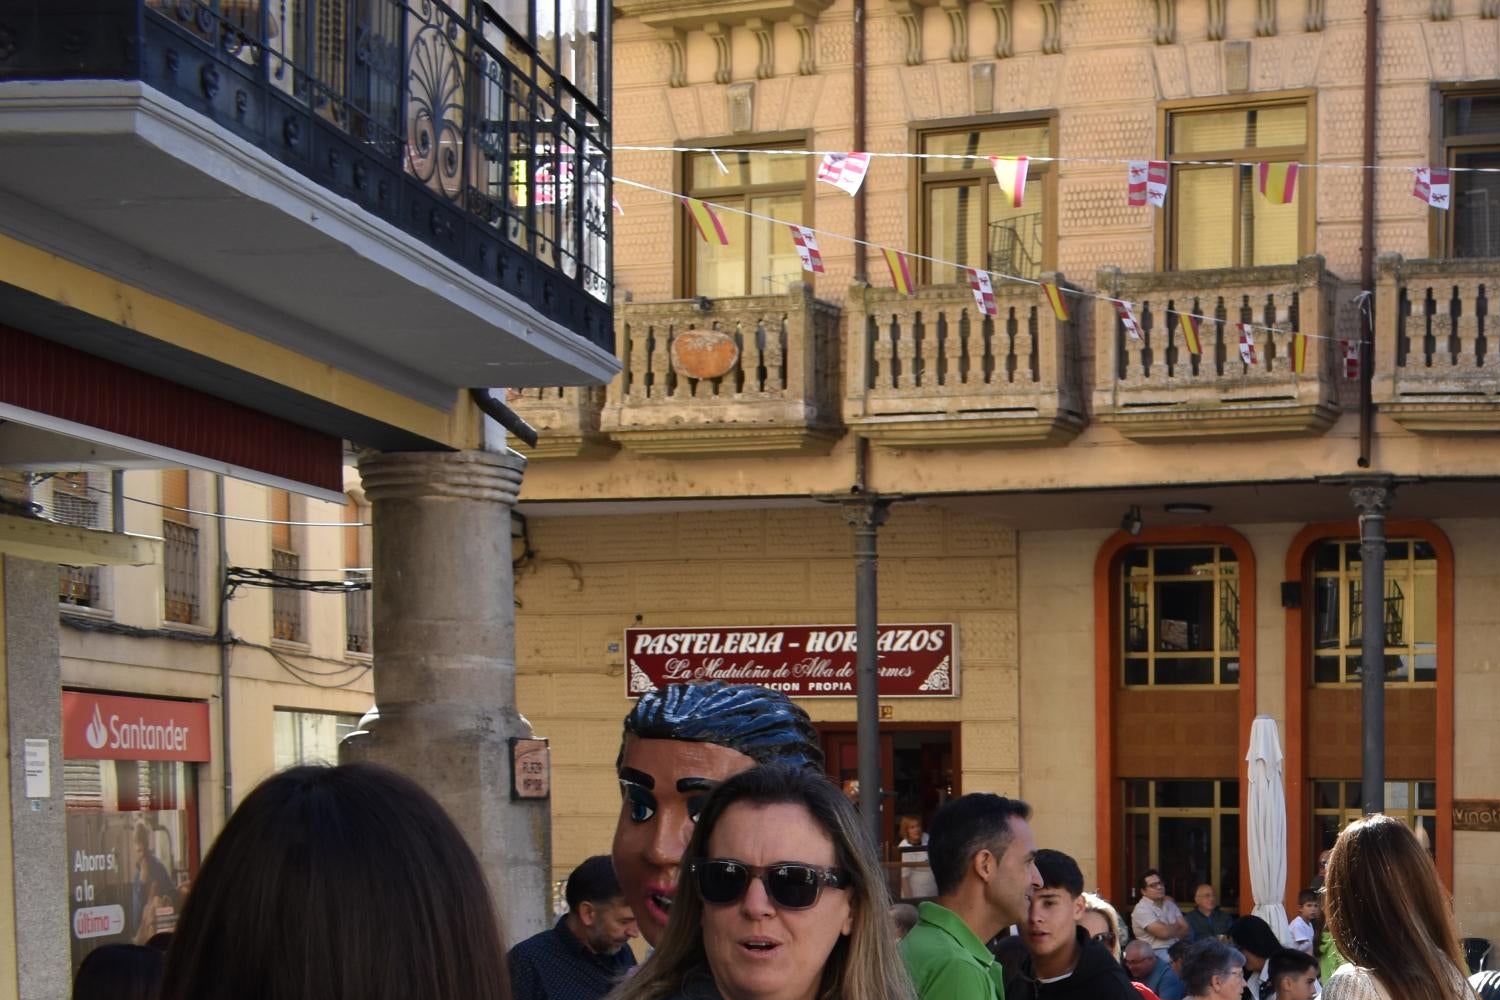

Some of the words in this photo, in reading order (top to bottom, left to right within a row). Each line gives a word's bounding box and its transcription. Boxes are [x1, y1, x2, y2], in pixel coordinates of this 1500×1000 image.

[634, 632, 784, 655] PASTELERIA
[806, 629, 945, 653] HORAZOS
[662, 657, 692, 679] La
[694, 657, 772, 679] Madrileña
[772, 662, 791, 678] de
[792, 656, 835, 678] Alba
[835, 661, 854, 678] de
[808, 682, 852, 691] PROPIA
[110, 714, 189, 751] Santander
[74, 849, 105, 873] Ahora
[76, 884, 83, 902] a
[84, 879, 94, 901] la
[76, 911, 110, 935] última
